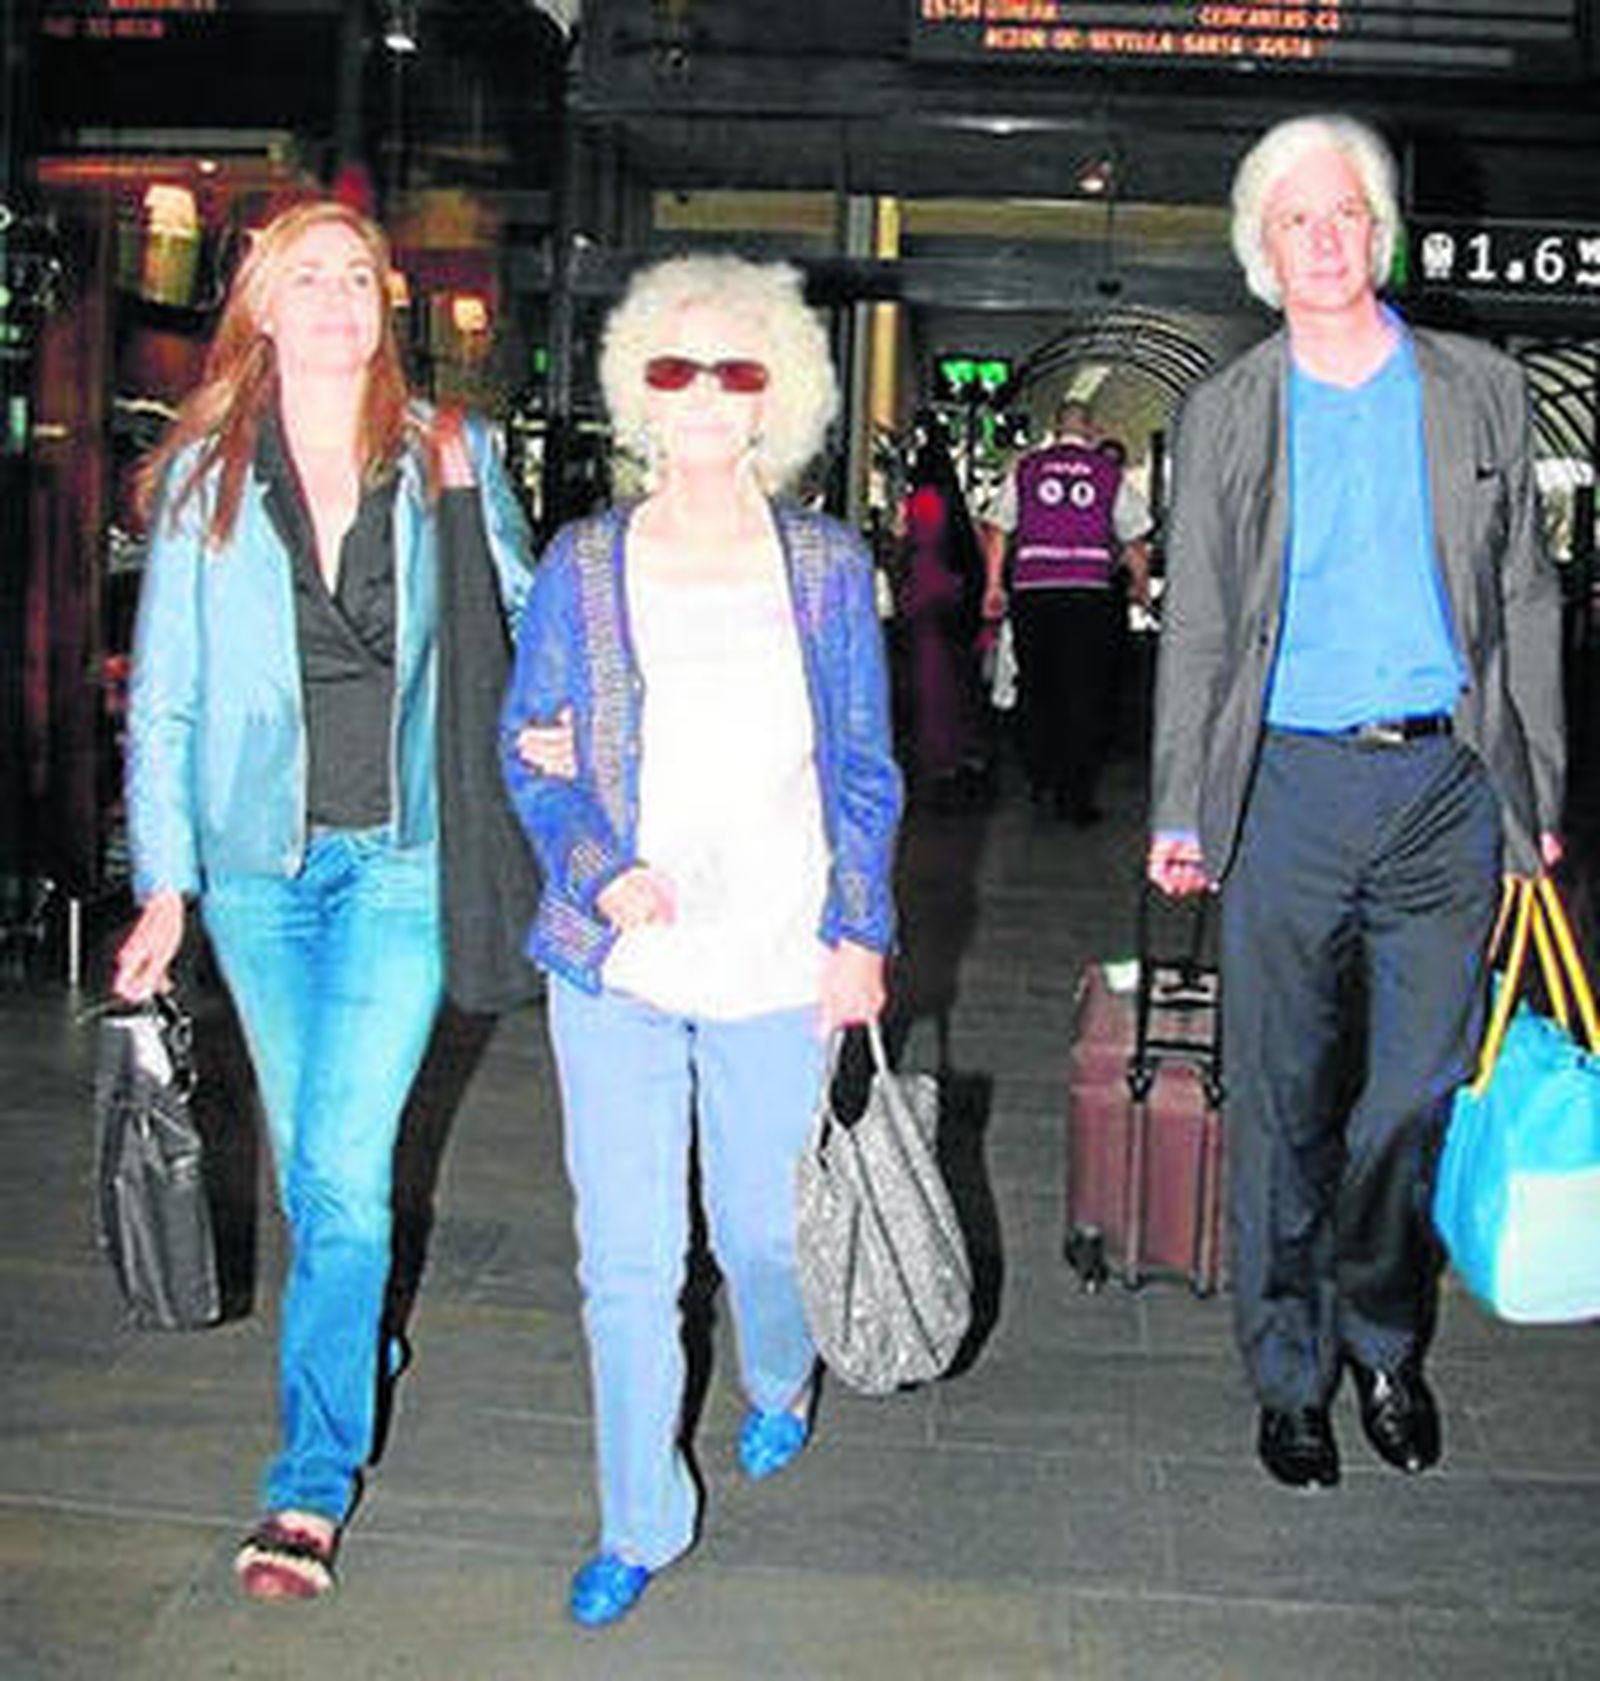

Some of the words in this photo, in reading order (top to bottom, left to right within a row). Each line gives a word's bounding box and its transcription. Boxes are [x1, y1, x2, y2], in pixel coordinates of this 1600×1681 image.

[1088, 28, 1174, 54] SEVILLA
[1182, 32, 1243, 56] SANTA
[1466, 233, 1566, 284] 1.6
